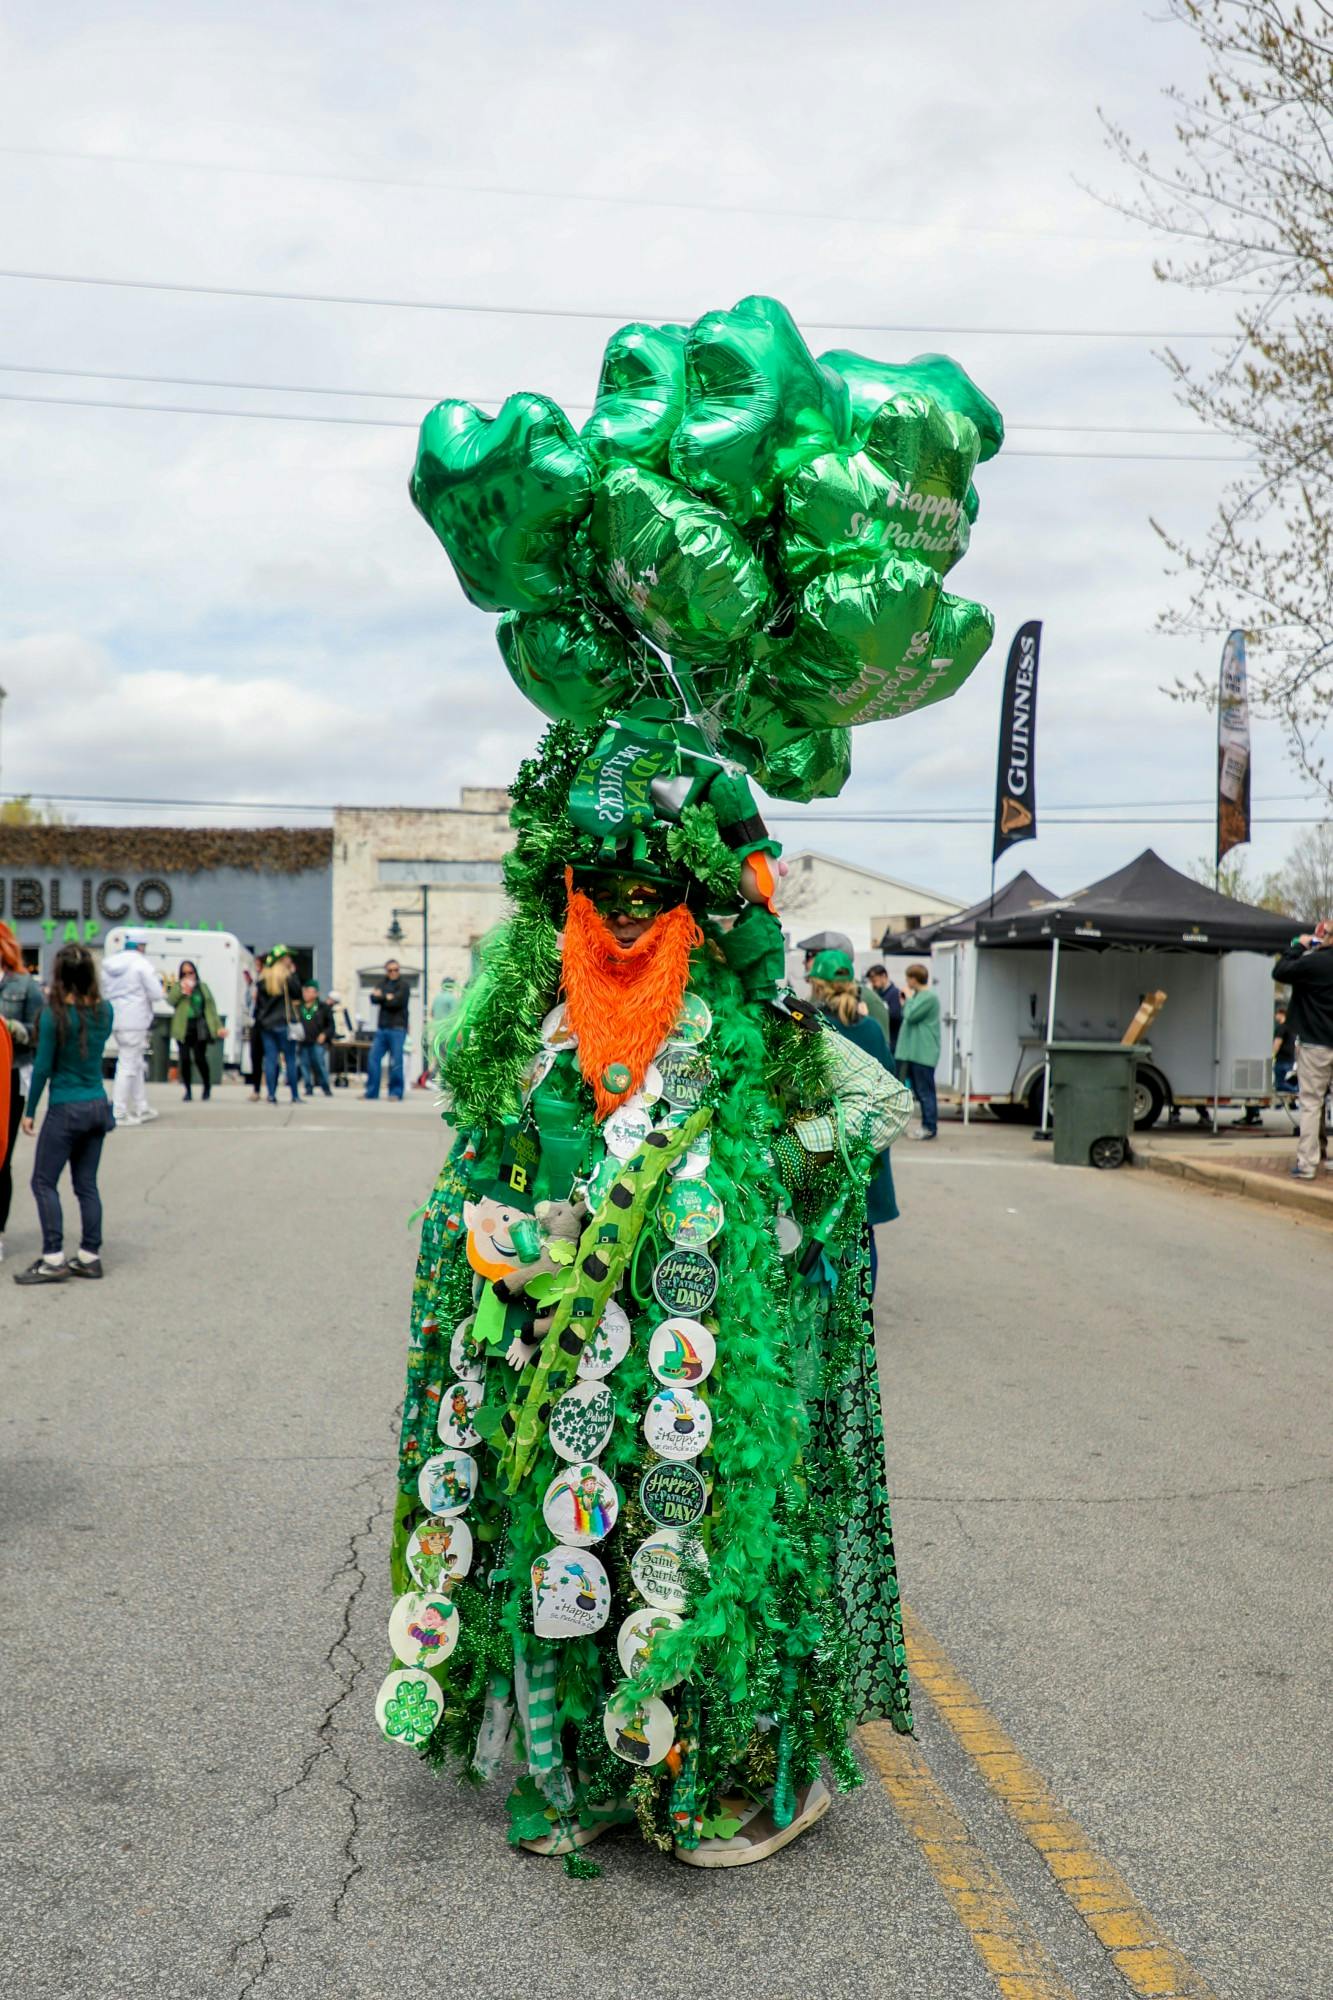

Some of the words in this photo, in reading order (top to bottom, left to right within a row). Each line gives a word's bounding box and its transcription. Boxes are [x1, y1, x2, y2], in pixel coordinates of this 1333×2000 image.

[886, 481, 963, 531] Happy
[829, 662, 890, 707] Day
[1007, 636, 1035, 796] GUINNESS
[0, 878, 172, 921] BLICO
[41, 920, 100, 944] TAP
[659, 1259, 713, 1281] Happy
[661, 1279, 672, 1287] ST.
[672, 1276, 713, 1295] PATRICK'S
[675, 1288, 708, 1307] DAY!
[585, 1423, 607, 1436] Day
[661, 1431, 696, 1446] Happy
[646, 1473, 699, 1495] Happy
[660, 1490, 700, 1509] PATRICK'S
[664, 1502, 697, 1521] DAY!
[641, 1551, 674, 1569] Saint
[645, 1579, 671, 1600] Day
[561, 1603, 594, 1622] Happy
